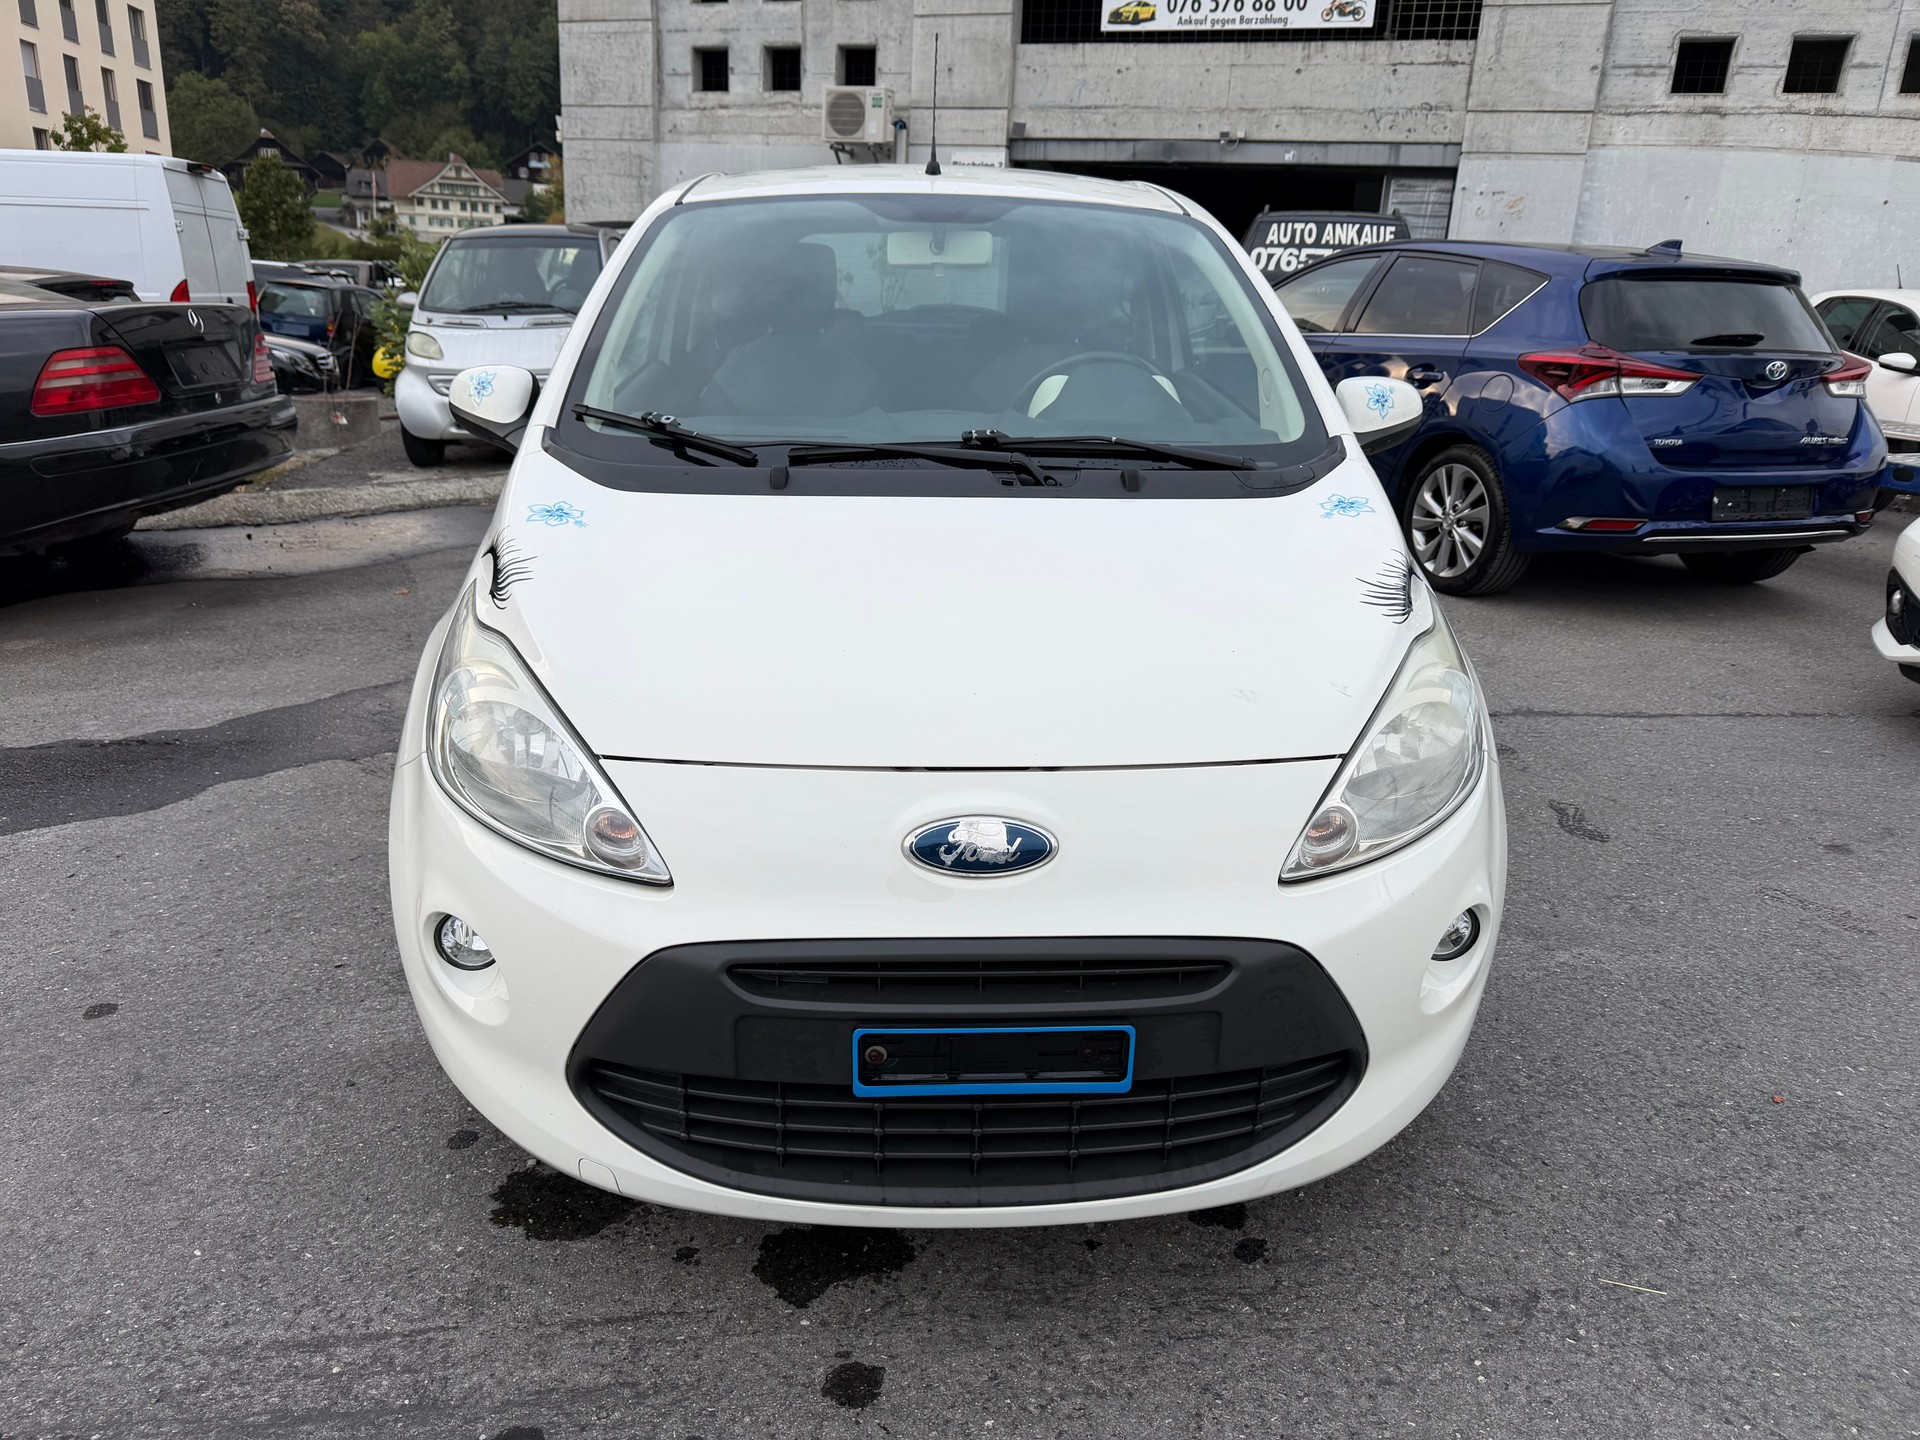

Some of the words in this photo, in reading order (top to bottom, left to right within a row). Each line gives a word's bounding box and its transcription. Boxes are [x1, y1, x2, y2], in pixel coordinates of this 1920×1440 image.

[1176, 15, 1208, 26] Ankauf
[1210, 16, 1236, 28] gegen
[1239, 14, 1289, 27] Barzahlung
[1265, 222, 1318, 245] AUTO
[1320, 223, 1397, 246] ANKAUF
[1653, 438, 1684, 446] TOYOTA
[1800, 436, 1828, 445] AURIS
[938, 830, 1023, 867] Ford
